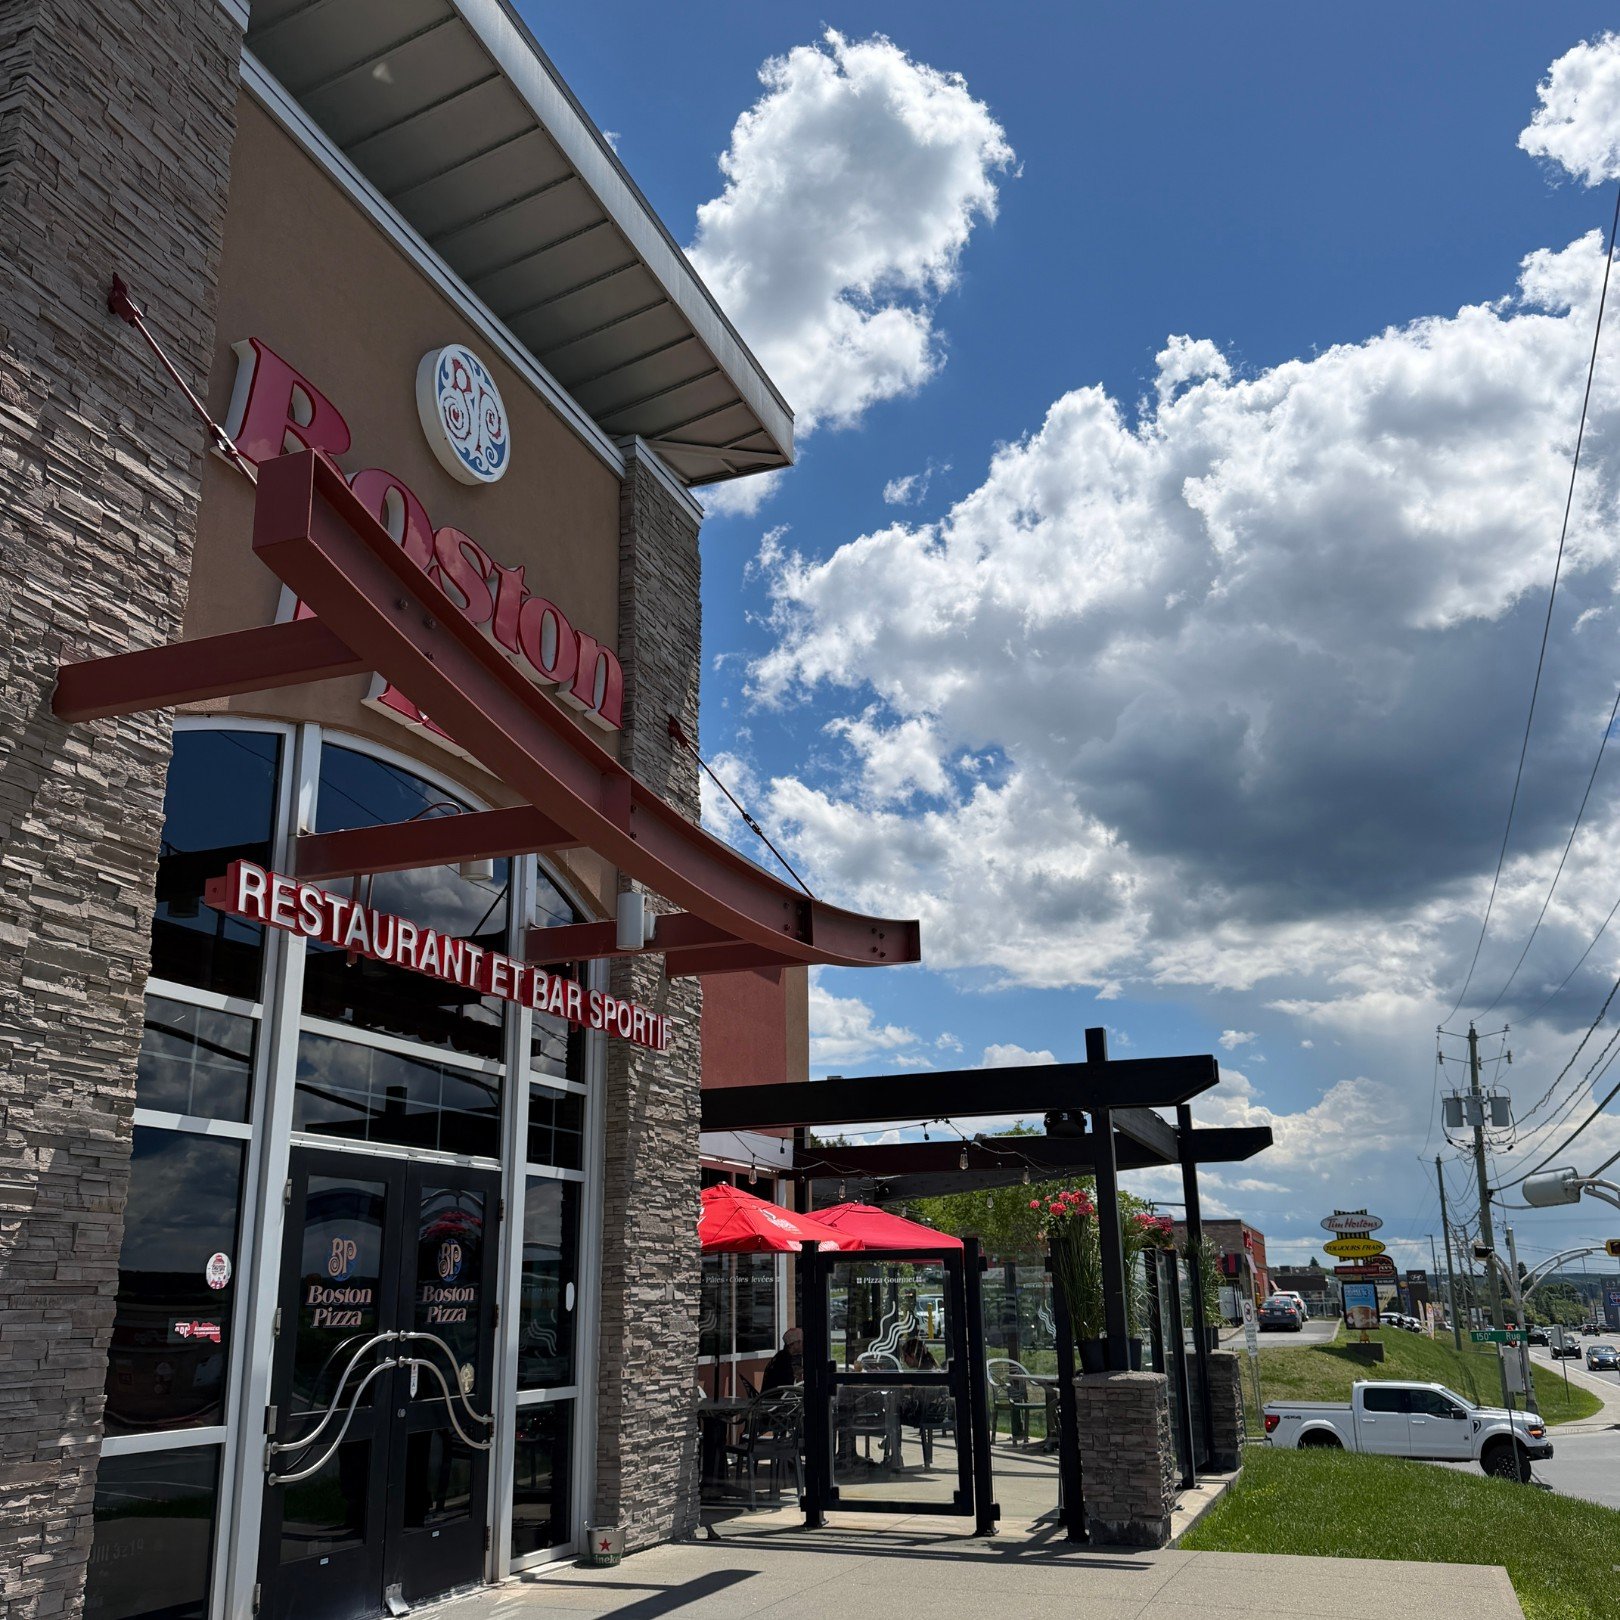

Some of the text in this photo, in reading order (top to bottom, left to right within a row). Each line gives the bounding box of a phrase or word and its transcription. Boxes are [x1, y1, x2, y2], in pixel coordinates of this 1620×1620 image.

[224, 337, 625, 729] Boston
[236, 859, 674, 1051] RESTAURANT ET BAR SPORTIF
[1327, 1217, 1378, 1229] Tim Hortons
[863, 1275, 916, 1287] Pizza Gourmet
[307, 1285, 373, 1305] Boston
[422, 1285, 475, 1303] Boston
[311, 1306, 363, 1328] Pizza
[426, 1304, 468, 1324] Pizza
[1505, 1331, 1521, 1341] Rue
